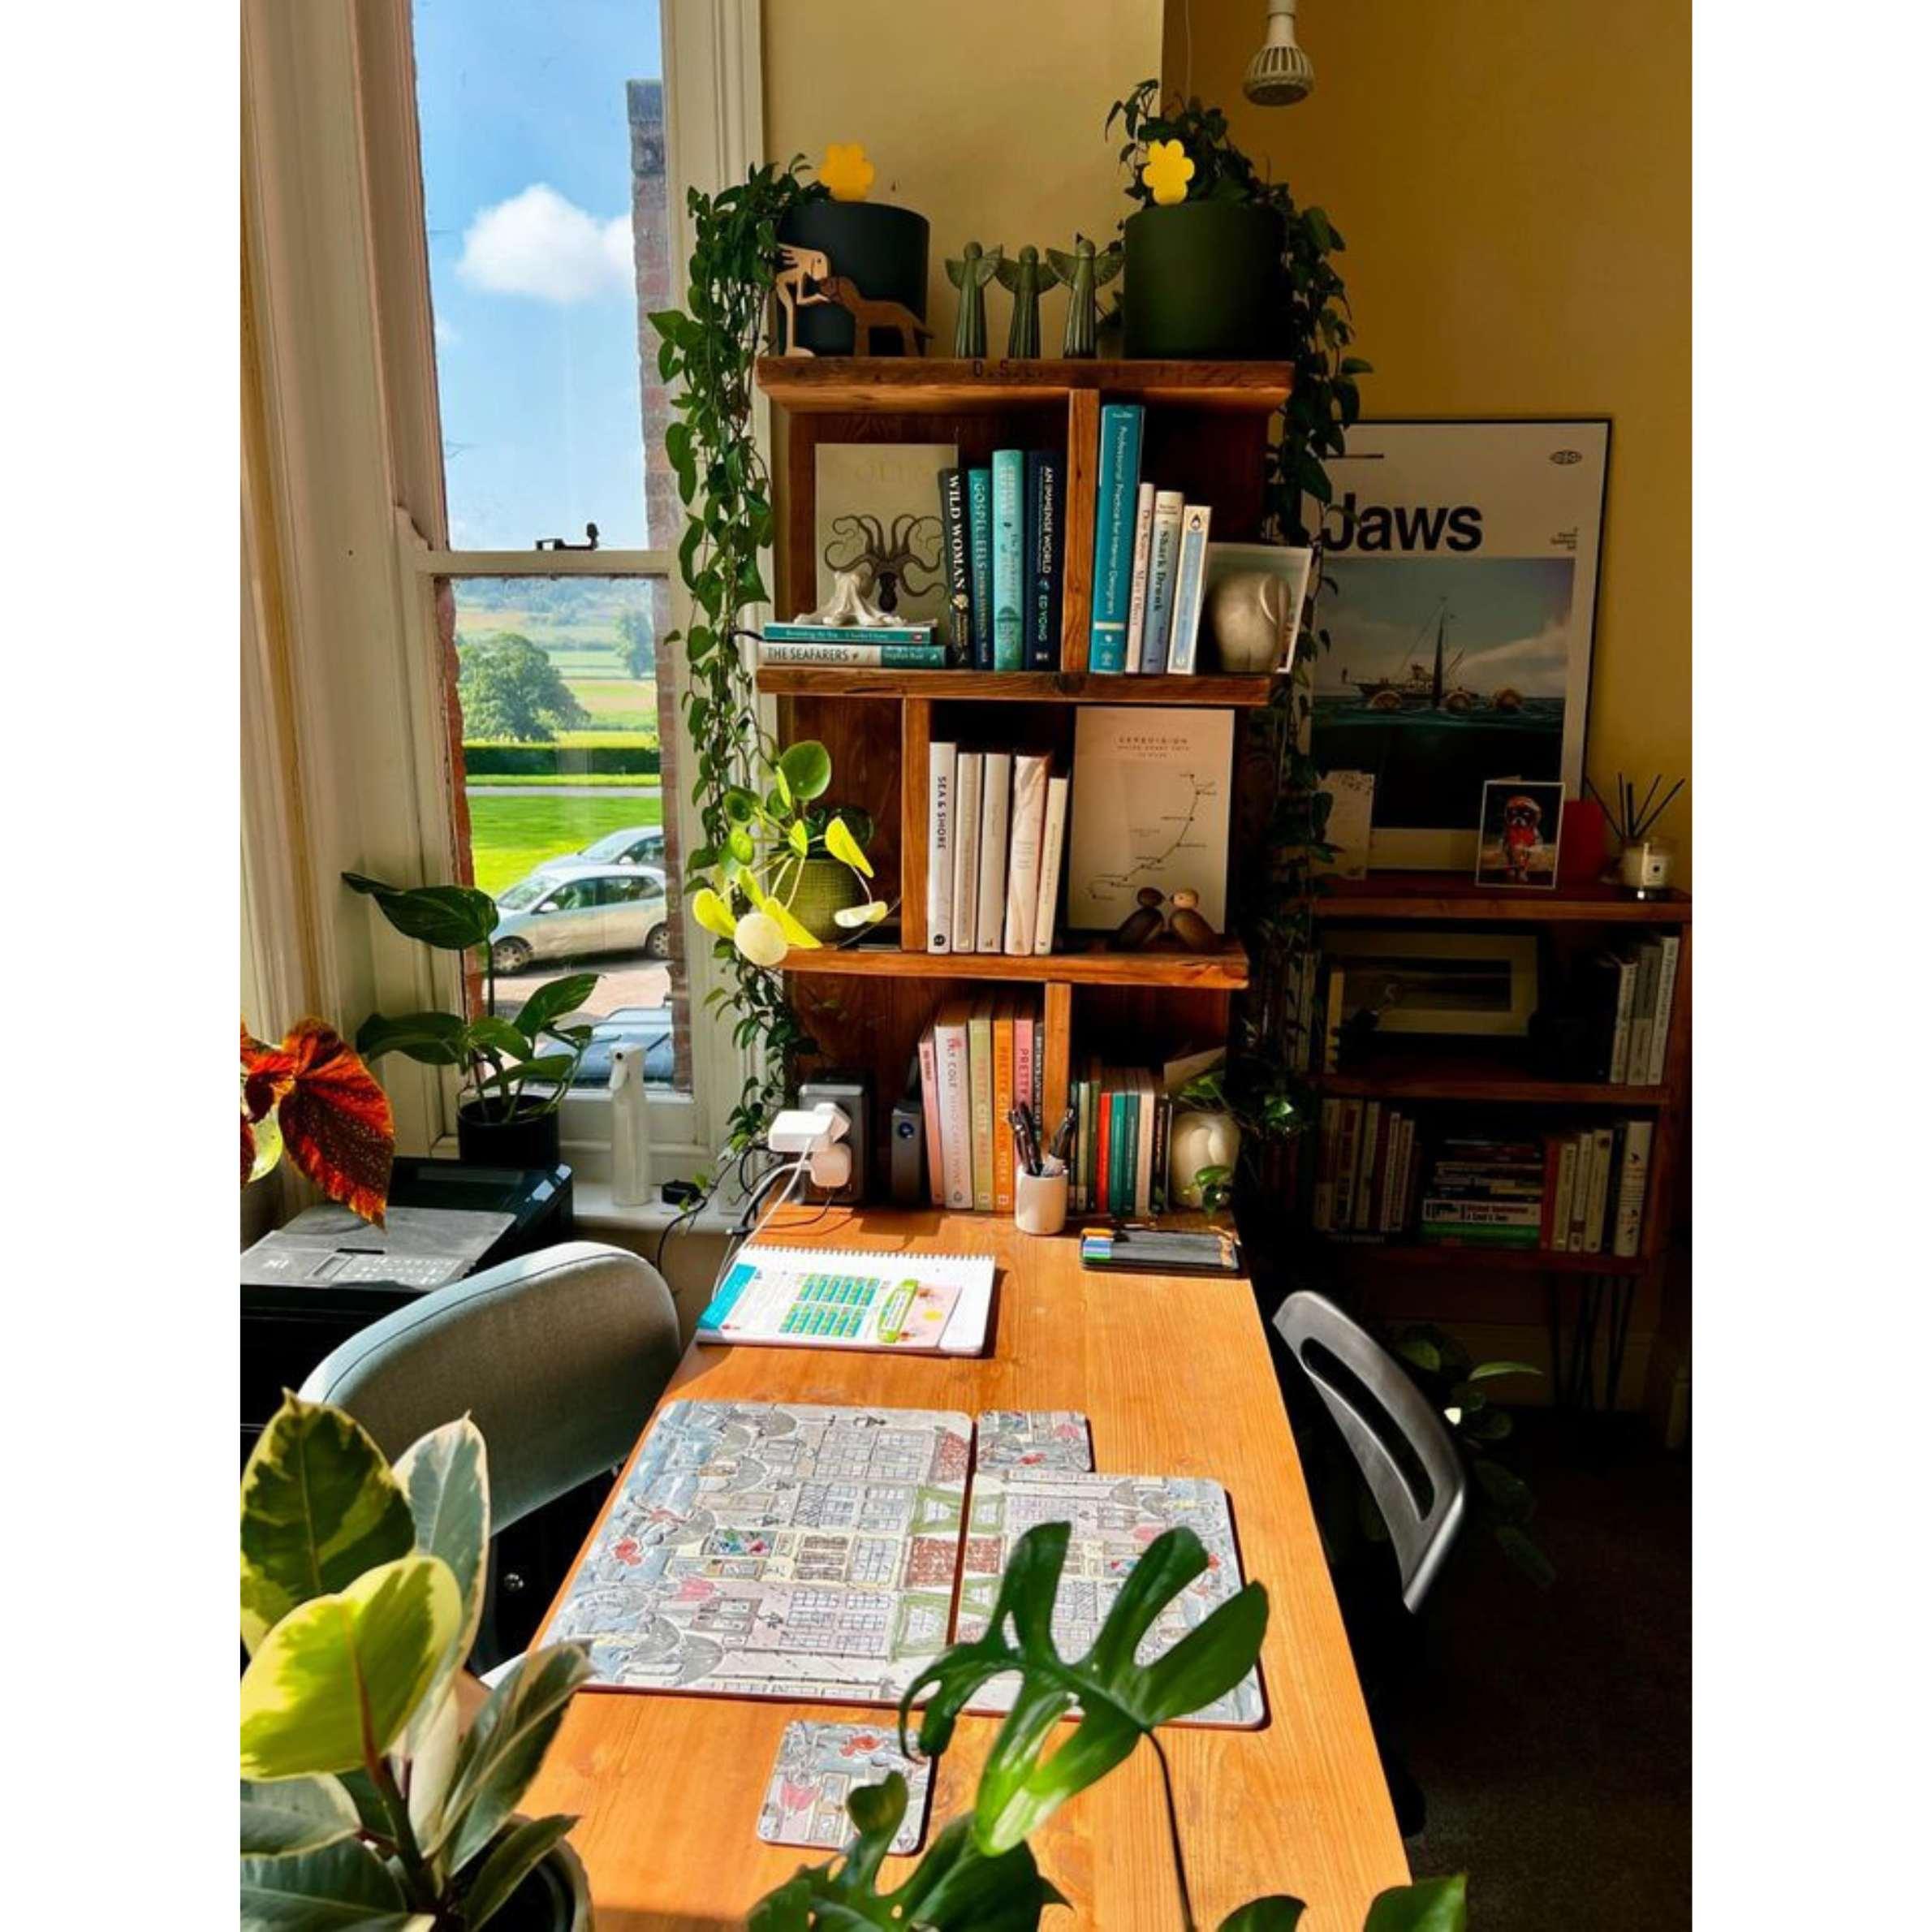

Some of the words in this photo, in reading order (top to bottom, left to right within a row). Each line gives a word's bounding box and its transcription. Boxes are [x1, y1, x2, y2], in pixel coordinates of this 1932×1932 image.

[1044, 466, 1054, 483] AN
[948, 474, 962, 520] WILD
[973, 483, 986, 531] GOSPEL
[1042, 485, 1054, 533] IMMENSE
[1111, 482, 1125, 520] Practice
[1321, 492, 1482, 552] Jaws
[951, 523, 967, 590] WOMAN
[976, 539, 988, 569] EELS
[1041, 534, 1053, 574] WORLD
[1156, 529, 1170, 567] Shark
[1037, 594, 1048, 610] ED
[1153, 571, 1167, 613] Drunk
[766, 648, 787, 661] THE
[789, 648, 848, 662] SEAFARERS
[937, 800, 947, 809] &
[938, 775, 947, 798] SEA
[936, 810, 947, 851] SHORE
[1017, 1047, 1029, 1094] PRETTY
[998, 1093, 1009, 1122] CITY
